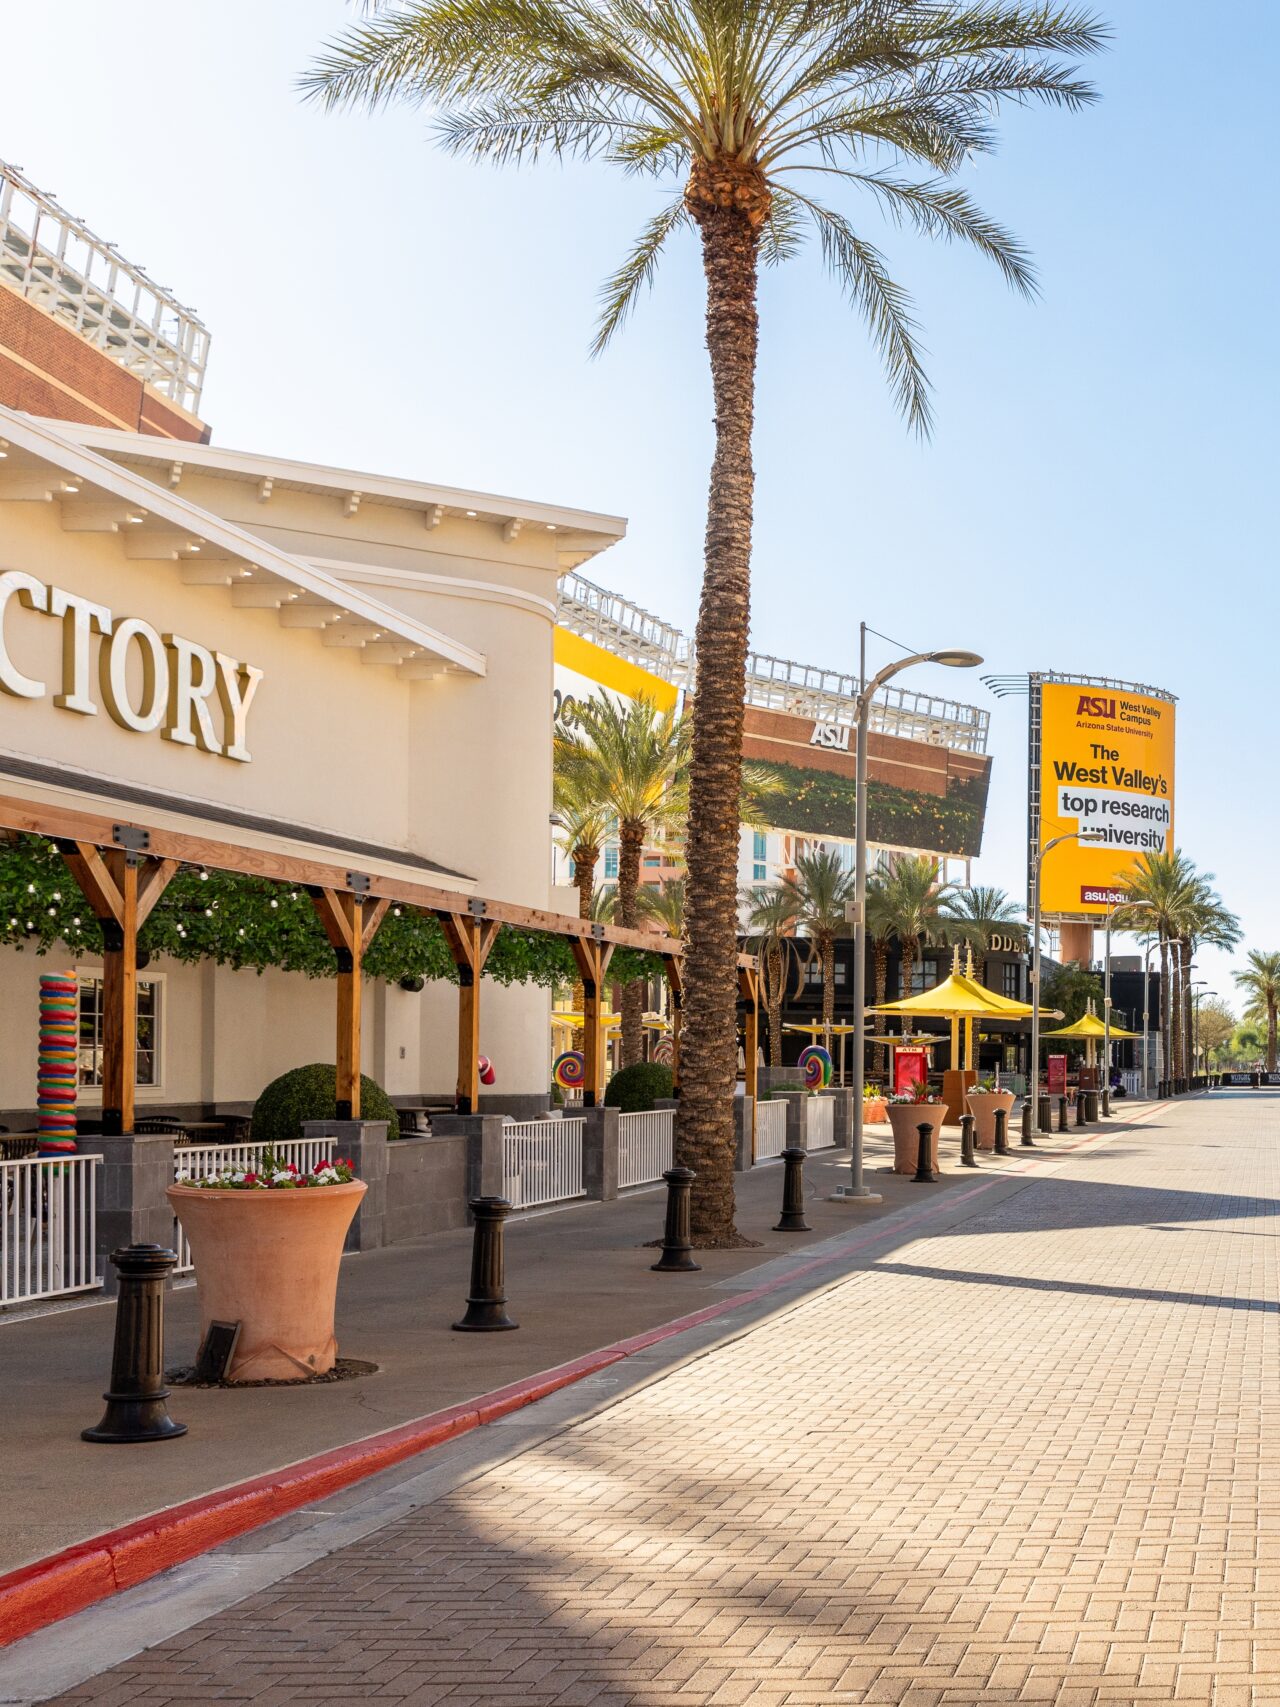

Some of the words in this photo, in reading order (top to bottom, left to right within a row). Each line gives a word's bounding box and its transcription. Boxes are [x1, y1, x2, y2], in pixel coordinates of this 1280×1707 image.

[0, 569, 264, 763] CTORY
[1076, 696, 1116, 719] ASU
[1120, 701, 1141, 713] West
[1142, 704, 1161, 719] Valley
[1120, 712, 1151, 725] Campus
[810, 721, 850, 752] ASU
[1076, 721, 1104, 730] Arizona
[1106, 724, 1124, 733] State
[1125, 727, 1153, 739] University
[1090, 744, 1119, 761] The
[1053, 761, 1108, 784] West
[1111, 766, 1167, 795] Valley's
[1062, 793, 1098, 816] top
[1101, 799, 1169, 823] research
